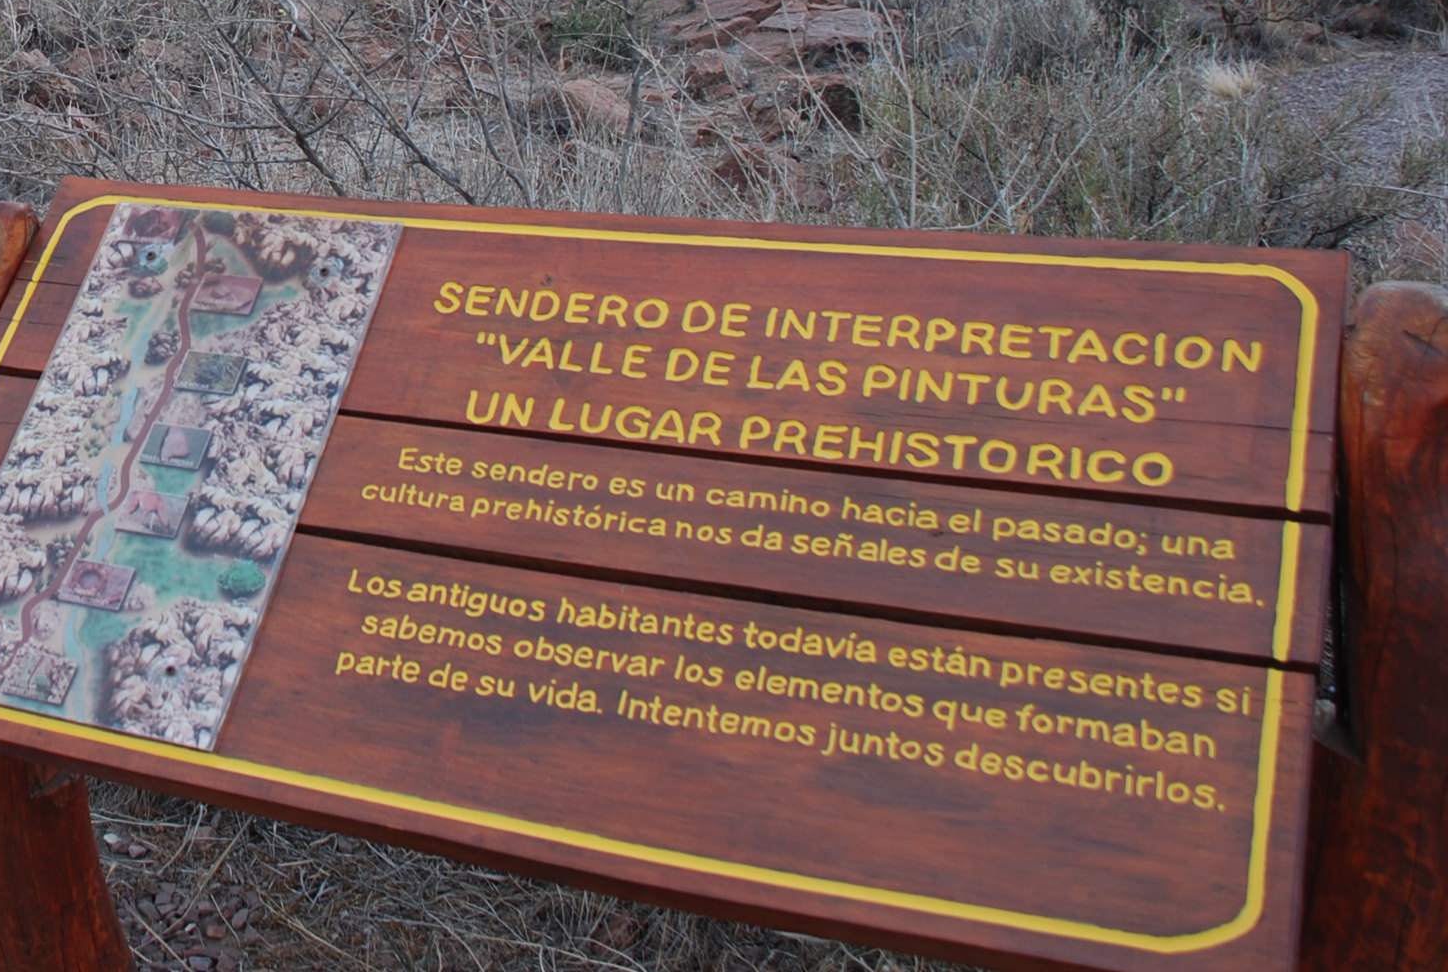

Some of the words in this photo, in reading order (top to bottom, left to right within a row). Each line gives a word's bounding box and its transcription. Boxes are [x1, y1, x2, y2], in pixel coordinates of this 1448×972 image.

[434, 281, 670, 328] SENDERO
[682, 300, 752, 337] DE
[765, 307, 1263, 372] INTERPRETACION
[476, 332, 654, 378] "VALLE
[665, 348, 737, 385] DE
[746, 354, 849, 396] LAS
[862, 364, 1187, 423] PINTURAS"
[465, 389, 536, 426] UN
[548, 397, 723, 446] LUGAR
[739, 415, 1174, 486] PREHISTORICO
[361, 484, 466, 512] cultura
[471, 497, 667, 536] prehistórica
[675, 520, 733, 544] nos
[740, 524, 783, 550] da
[790, 533, 928, 567] señales
[934, 546, 981, 573] de
[995, 557, 1040, 579] su
[1049, 560, 1264, 606] existencia.
[398, 447, 463, 475] Este
[471, 461, 600, 490] sendero
[608, 476, 646, 497] es
[656, 483, 695, 501] un
[706, 488, 831, 517] camino
[841, 496, 939, 529] hacia
[948, 509, 982, 532] el
[992, 517, 1148, 555] pasado;
[1161, 535, 1236, 559] una
[348, 568, 403, 598] Los
[405, 582, 546, 621] antiguos
[557, 596, 734, 645] habitantes
[743, 621, 877, 662] todavía
[888, 645, 992, 676] están
[1000, 661, 1203, 708] presentes
[1216, 686, 1252, 714] si
[361, 614, 503, 654] sabemos
[514, 636, 666, 676] observar
[674, 654, 724, 687] los
[735, 666, 924, 717] elementos
[932, 700, 1008, 730] que
[1015, 703, 1216, 758] formaban
[336, 652, 421, 682] parte
[428, 662, 469, 691] de
[475, 674, 516, 697] su
[529, 679, 603, 713] vida.
[618, 690, 817, 745] Intentemos
[820, 722, 945, 767] juntos
[954, 742, 1226, 811] descubrirlos.
